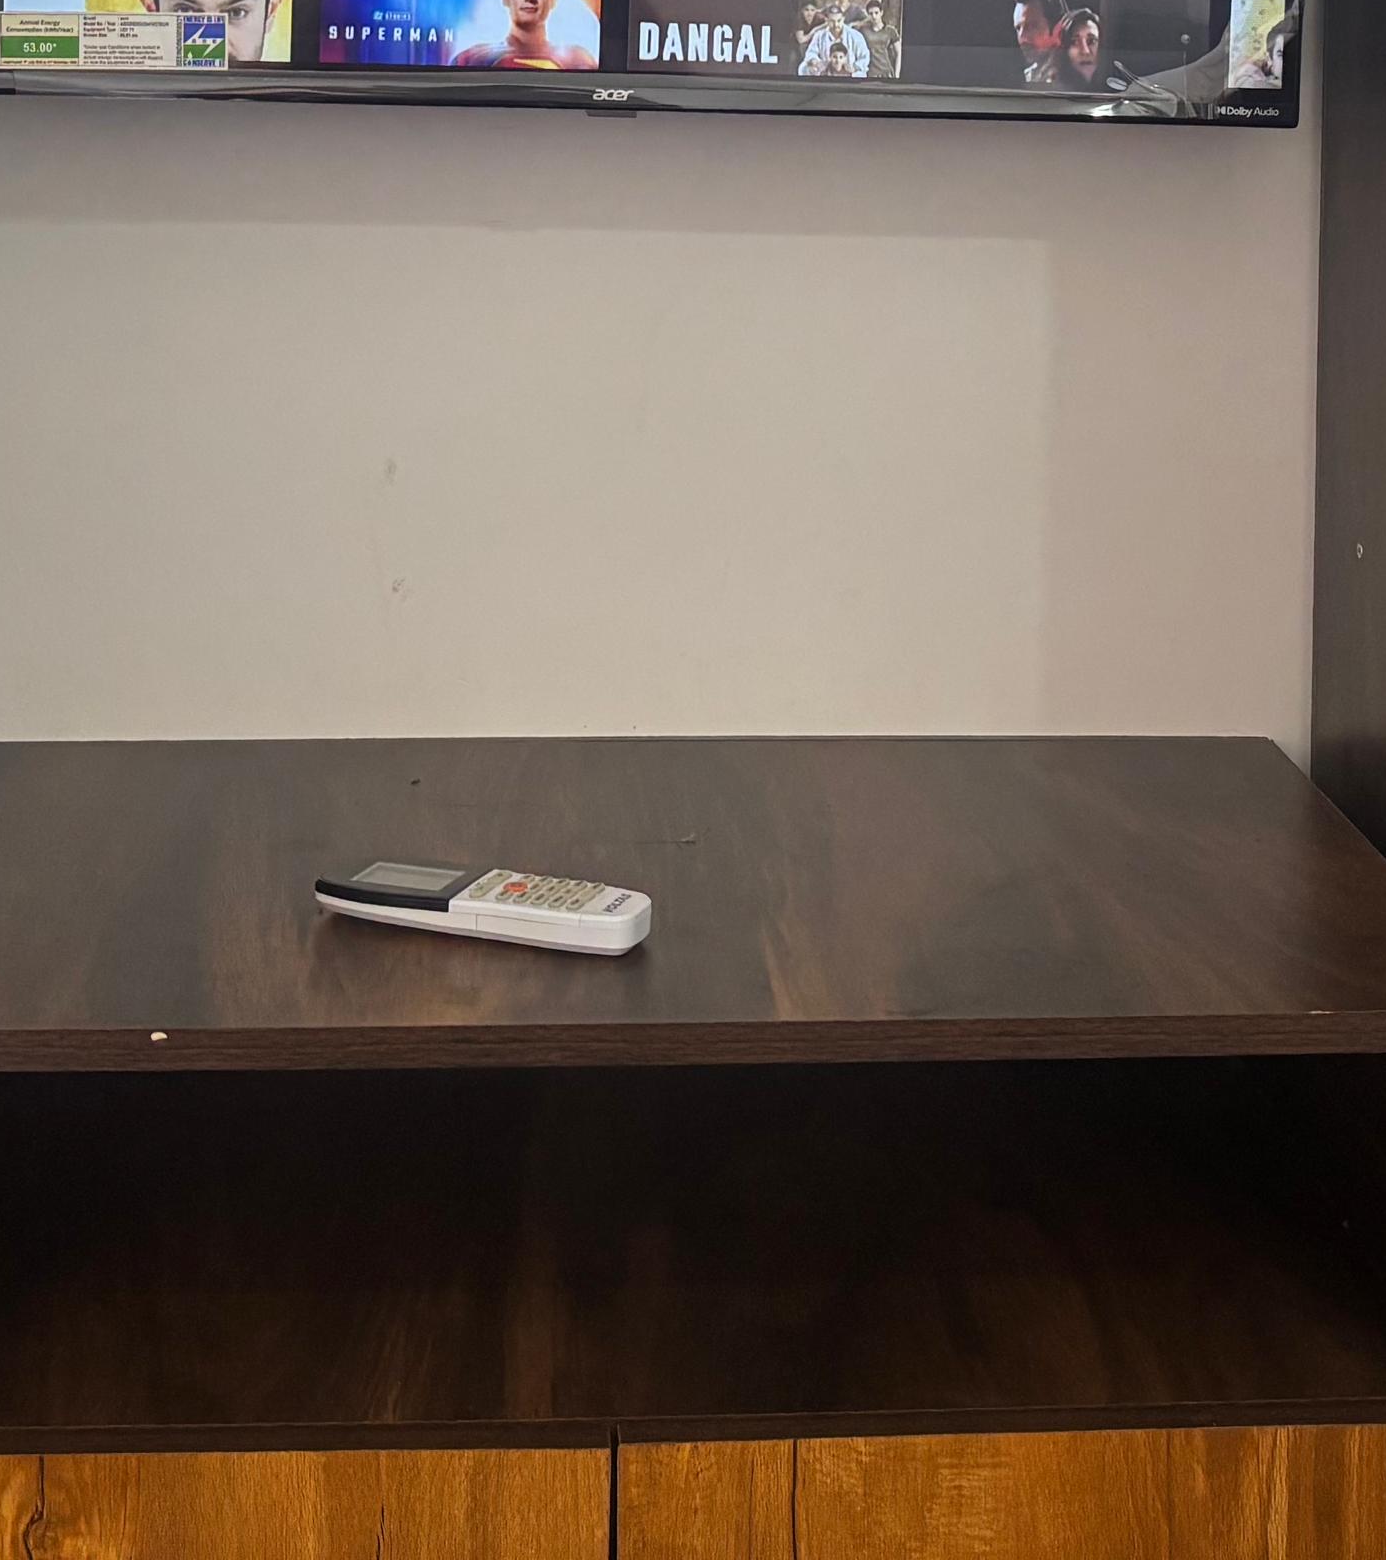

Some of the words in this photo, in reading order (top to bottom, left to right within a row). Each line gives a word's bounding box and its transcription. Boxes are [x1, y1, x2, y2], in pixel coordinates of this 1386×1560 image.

[328, 25, 454, 42] SUPERMAN
[639, 22, 778, 64] DANGAL
[592, 89, 635, 102] acer
[1226, 105, 1253, 118] Dolby
[1253, 106, 1280, 116] Audio
